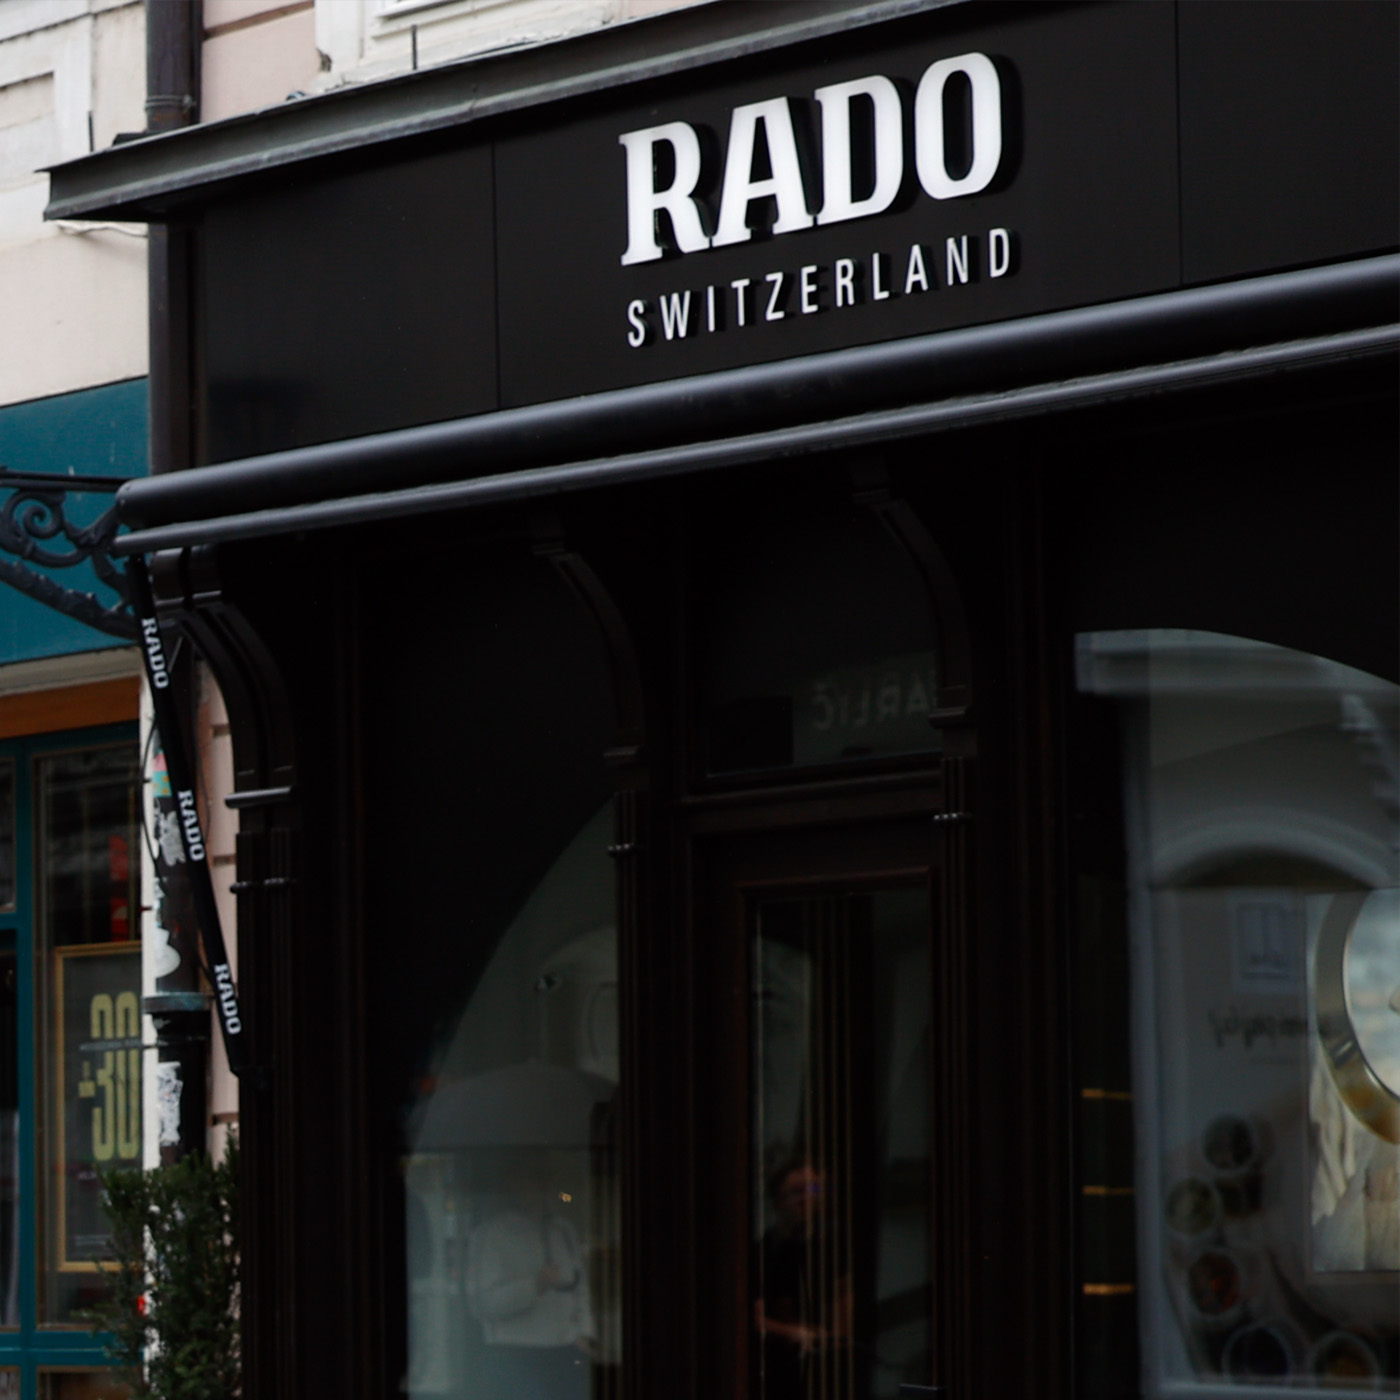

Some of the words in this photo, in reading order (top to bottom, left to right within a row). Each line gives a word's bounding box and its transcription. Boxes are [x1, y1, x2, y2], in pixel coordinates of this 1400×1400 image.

[618, 51, 1003, 266] RADO
[626, 227, 1011, 348] SWITZERLAND
[141, 616, 170, 690] RADO
[177, 789, 206, 863] RADO
[213, 962, 242, 1036] RADO
